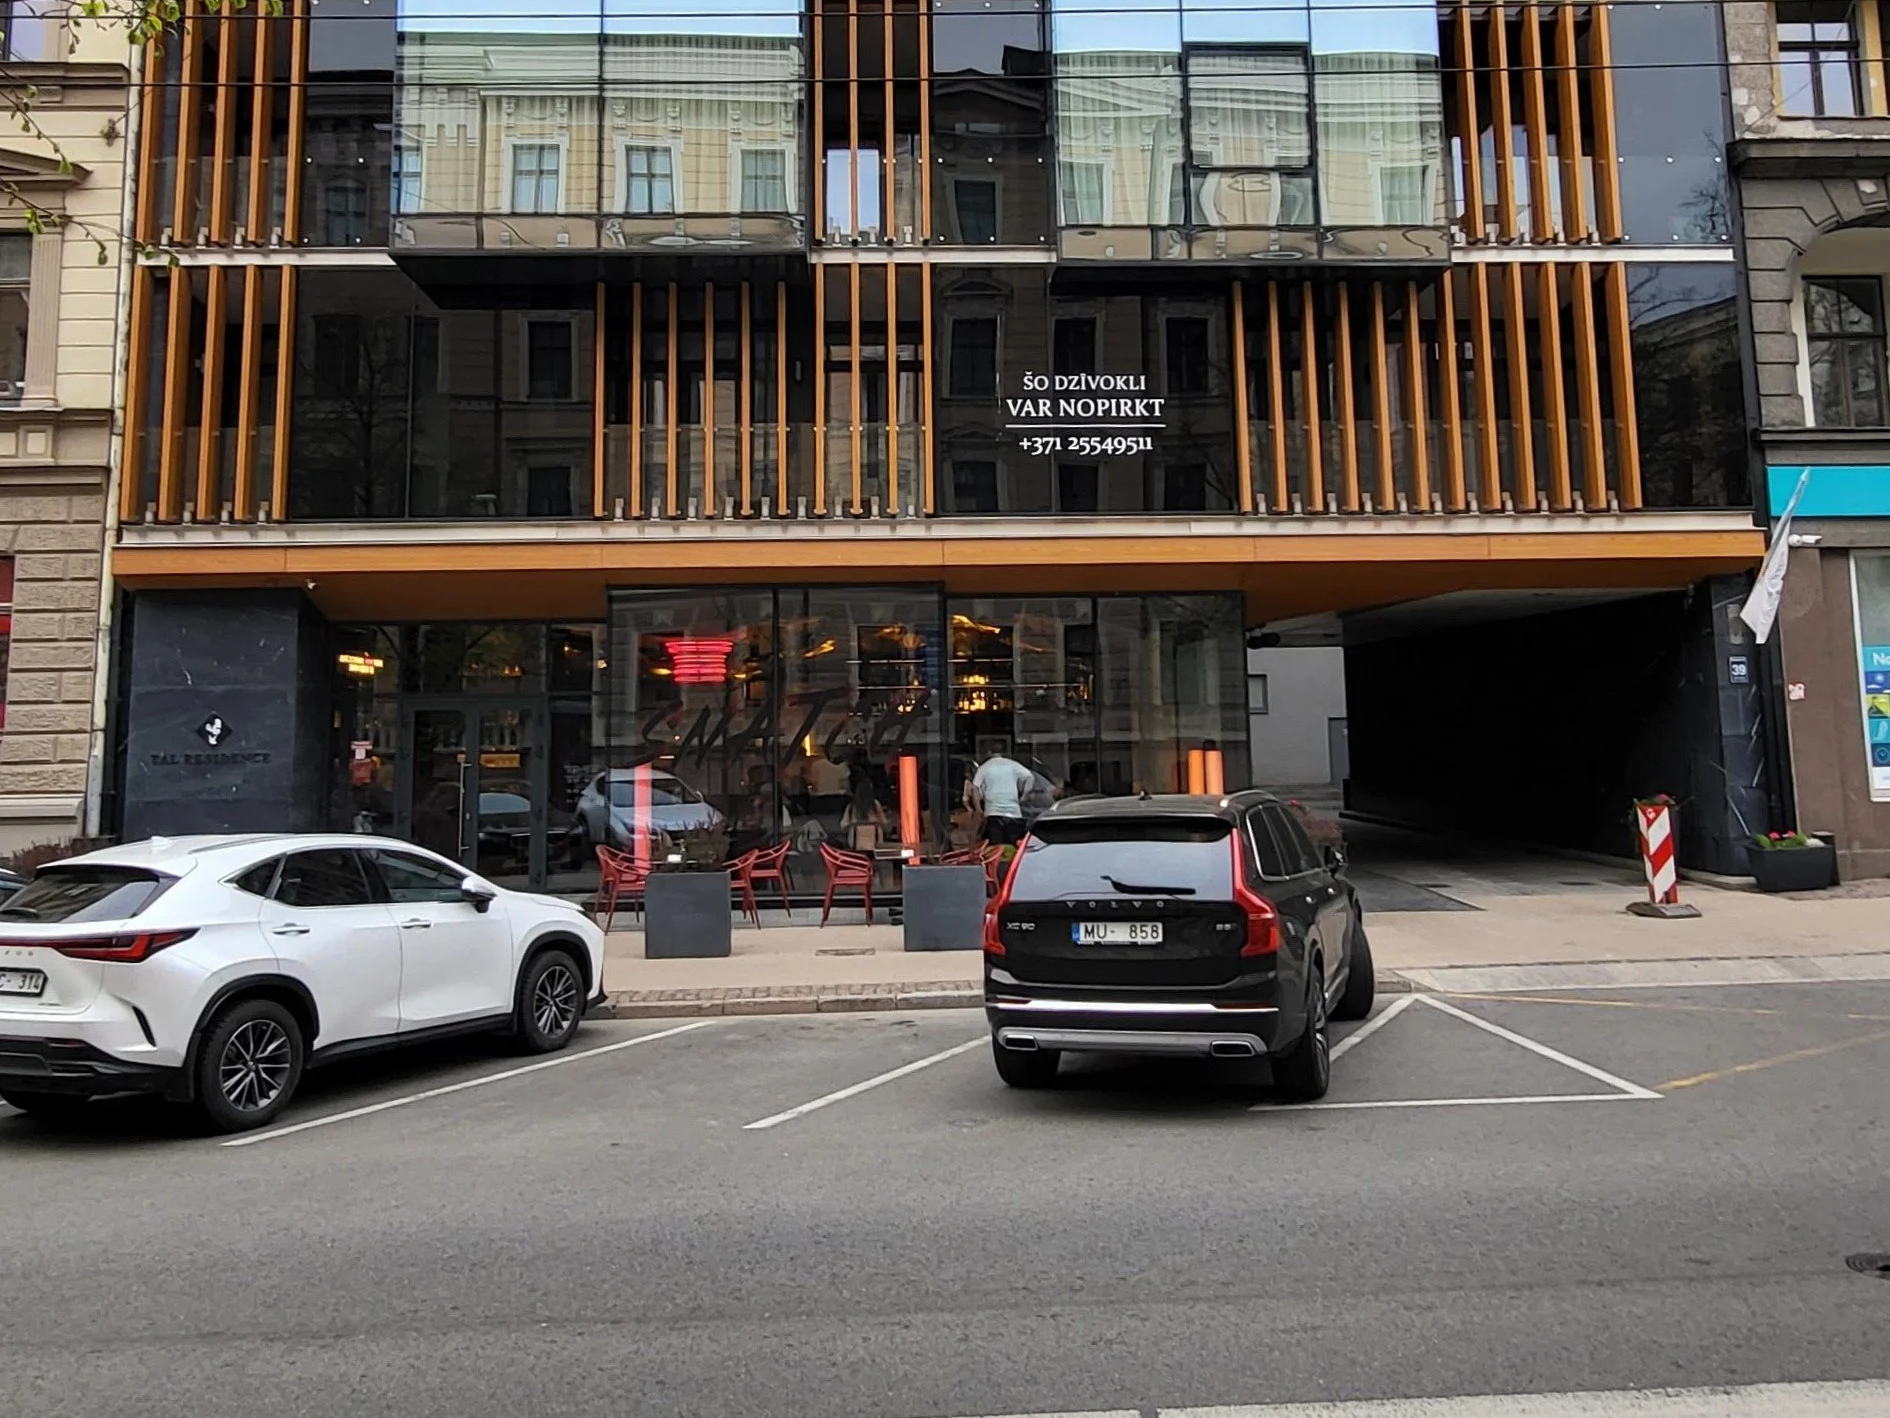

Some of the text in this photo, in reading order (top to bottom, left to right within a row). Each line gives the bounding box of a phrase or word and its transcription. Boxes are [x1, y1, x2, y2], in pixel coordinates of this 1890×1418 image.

[1023, 371, 1146, 391] ŠO DZĪVOKLI
[1006, 398, 1165, 417] VAR NOPIRKT
[1019, 437, 1153, 455] +371 25549511
[1731, 664, 1746, 676] 39
[184, 752, 272, 765] RESIDENCE
[1066, 901, 1164, 909] VOLVO
[1129, 923, 1160, 940] 858
